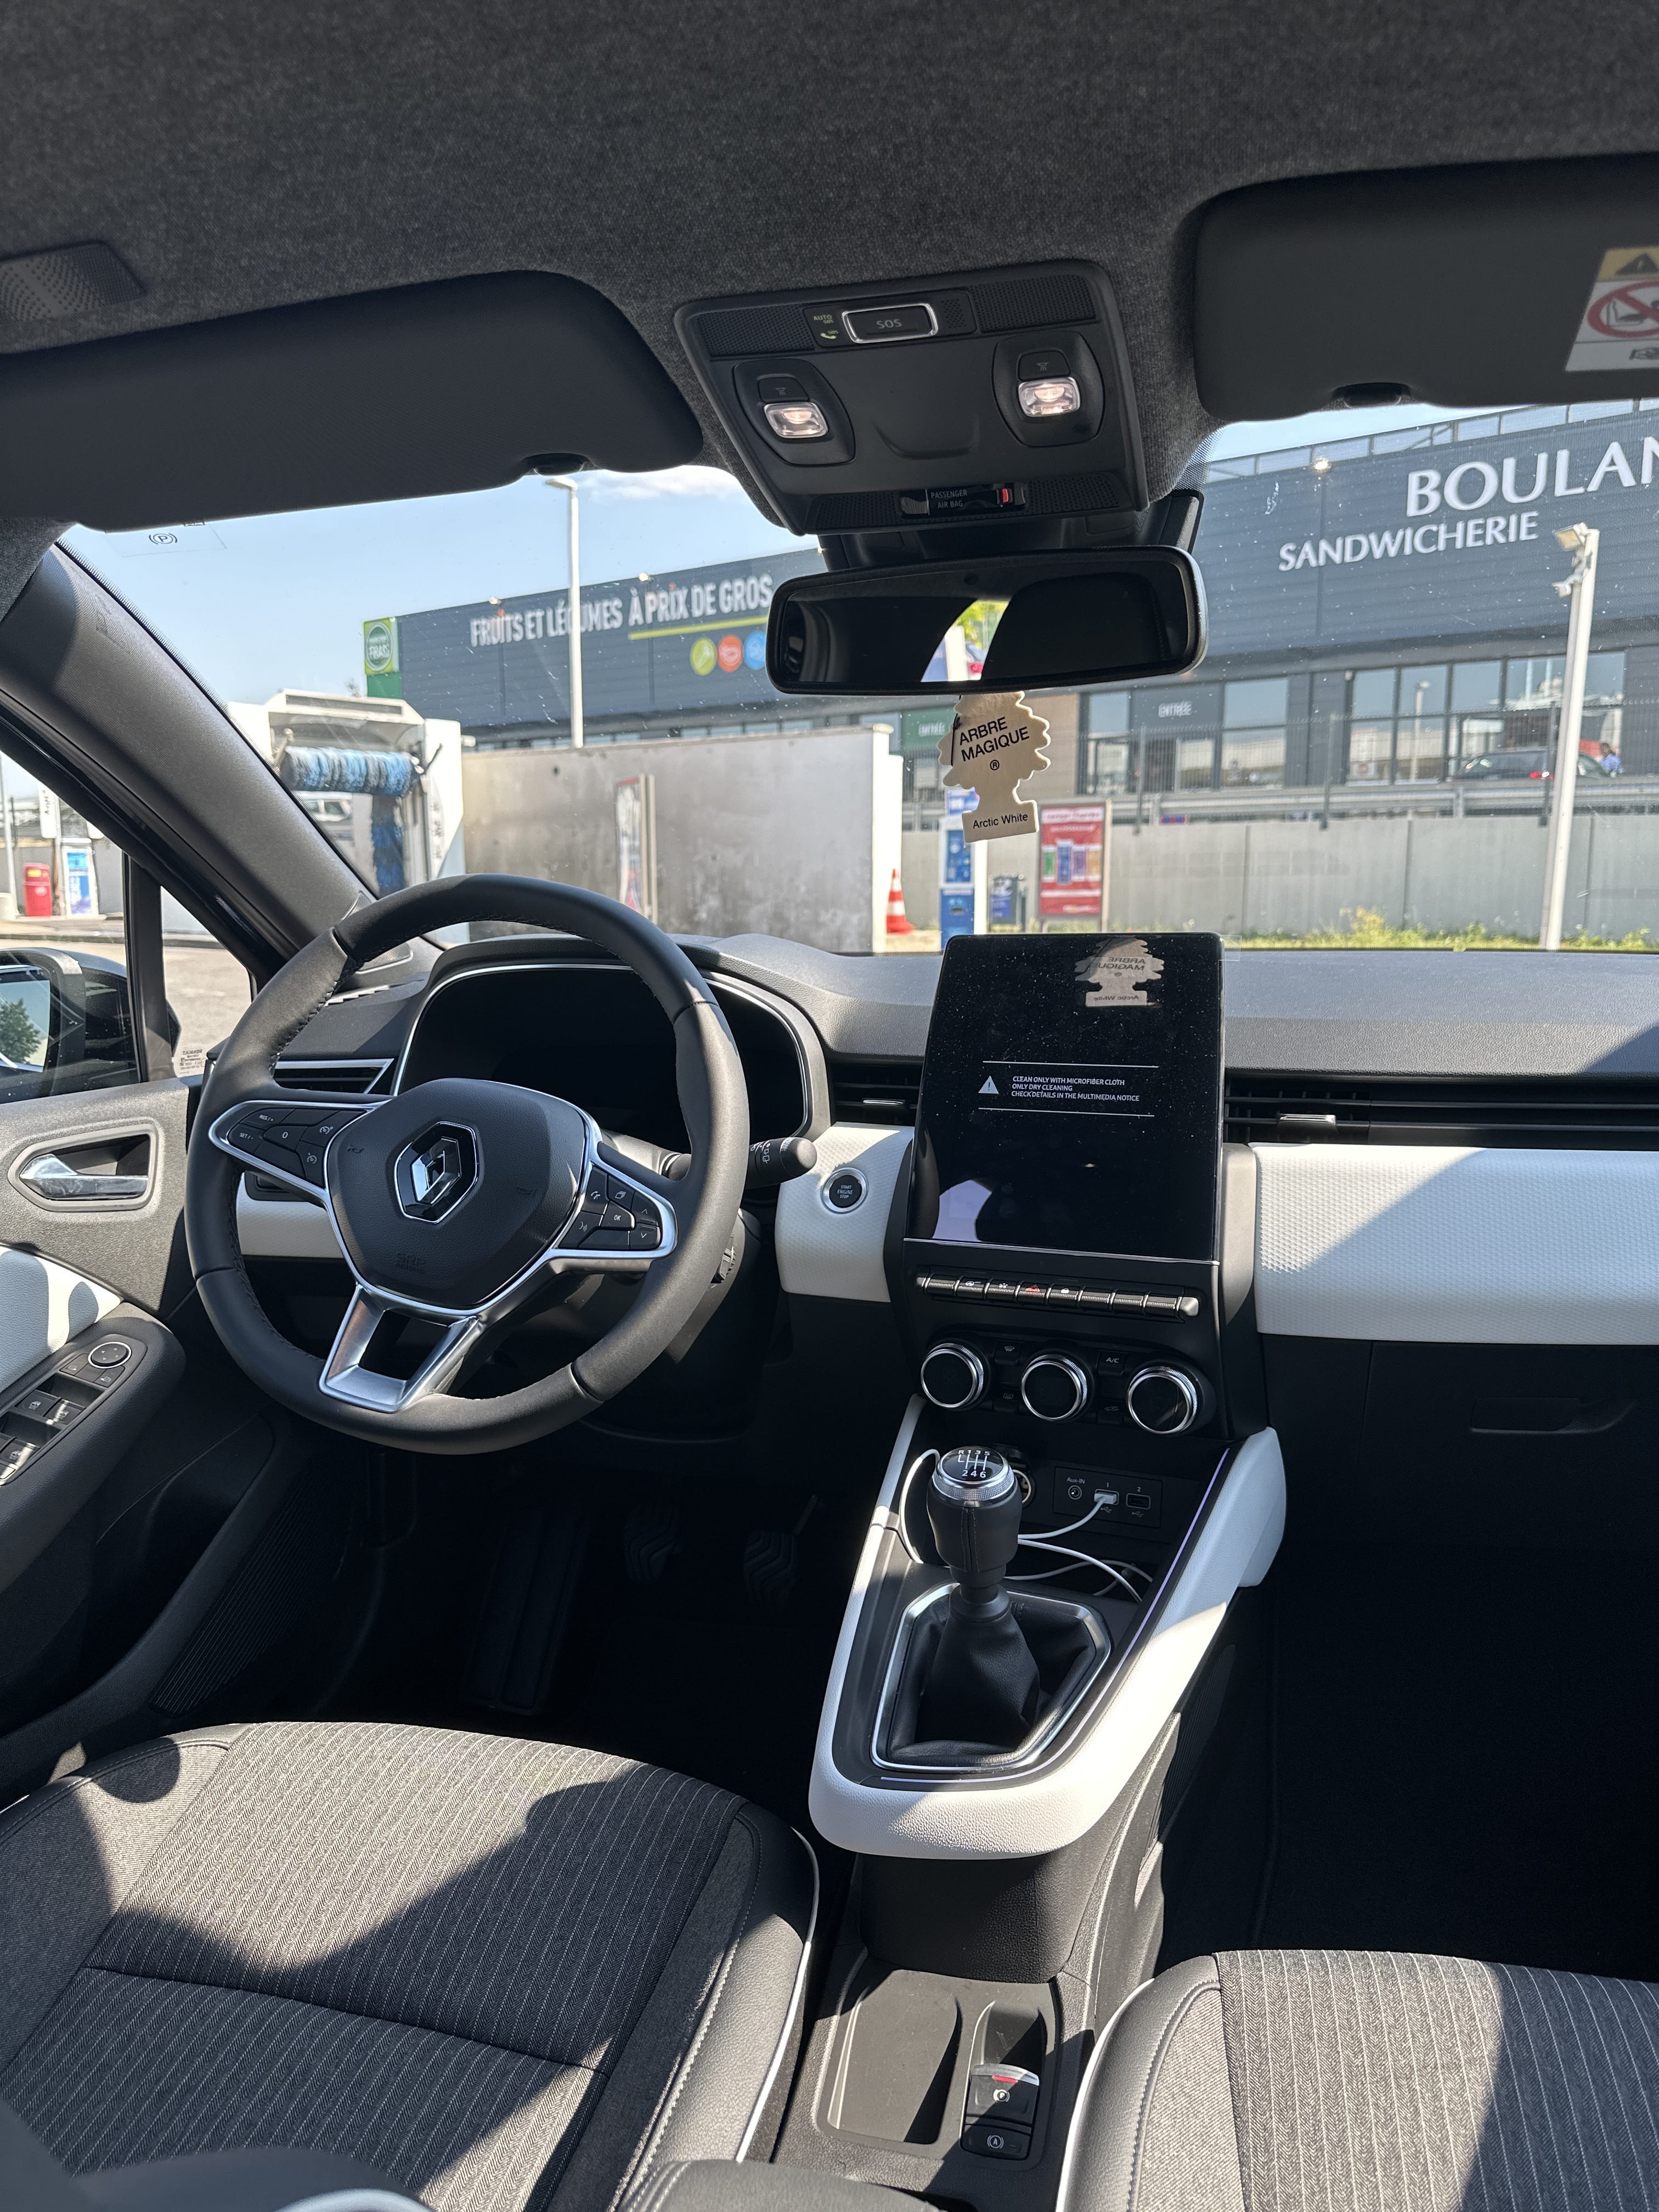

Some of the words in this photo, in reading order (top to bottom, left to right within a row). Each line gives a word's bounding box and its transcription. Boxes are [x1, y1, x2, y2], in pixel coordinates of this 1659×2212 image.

[877, 319, 902, 329] SOS
[931, 489, 968, 499] PASSENGER
[938, 500, 949, 509] AIR
[950, 500, 963, 508] BAG
[1279, 510, 1539, 572] SANDWICHERIE
[470, 608, 524, 647] FRUITS
[524, 608, 545, 641] ET
[628, 586, 644, 627] À
[645, 582, 689, 624] PRIX
[691, 582, 717, 618] DE
[719, 573, 774, 614] GROS
[960, 716, 1008, 746] ARBRE
[961, 726, 1030, 762] MAGIQUE
[973, 817, 999, 830] Arctic
[1001, 813, 1029, 825] White
